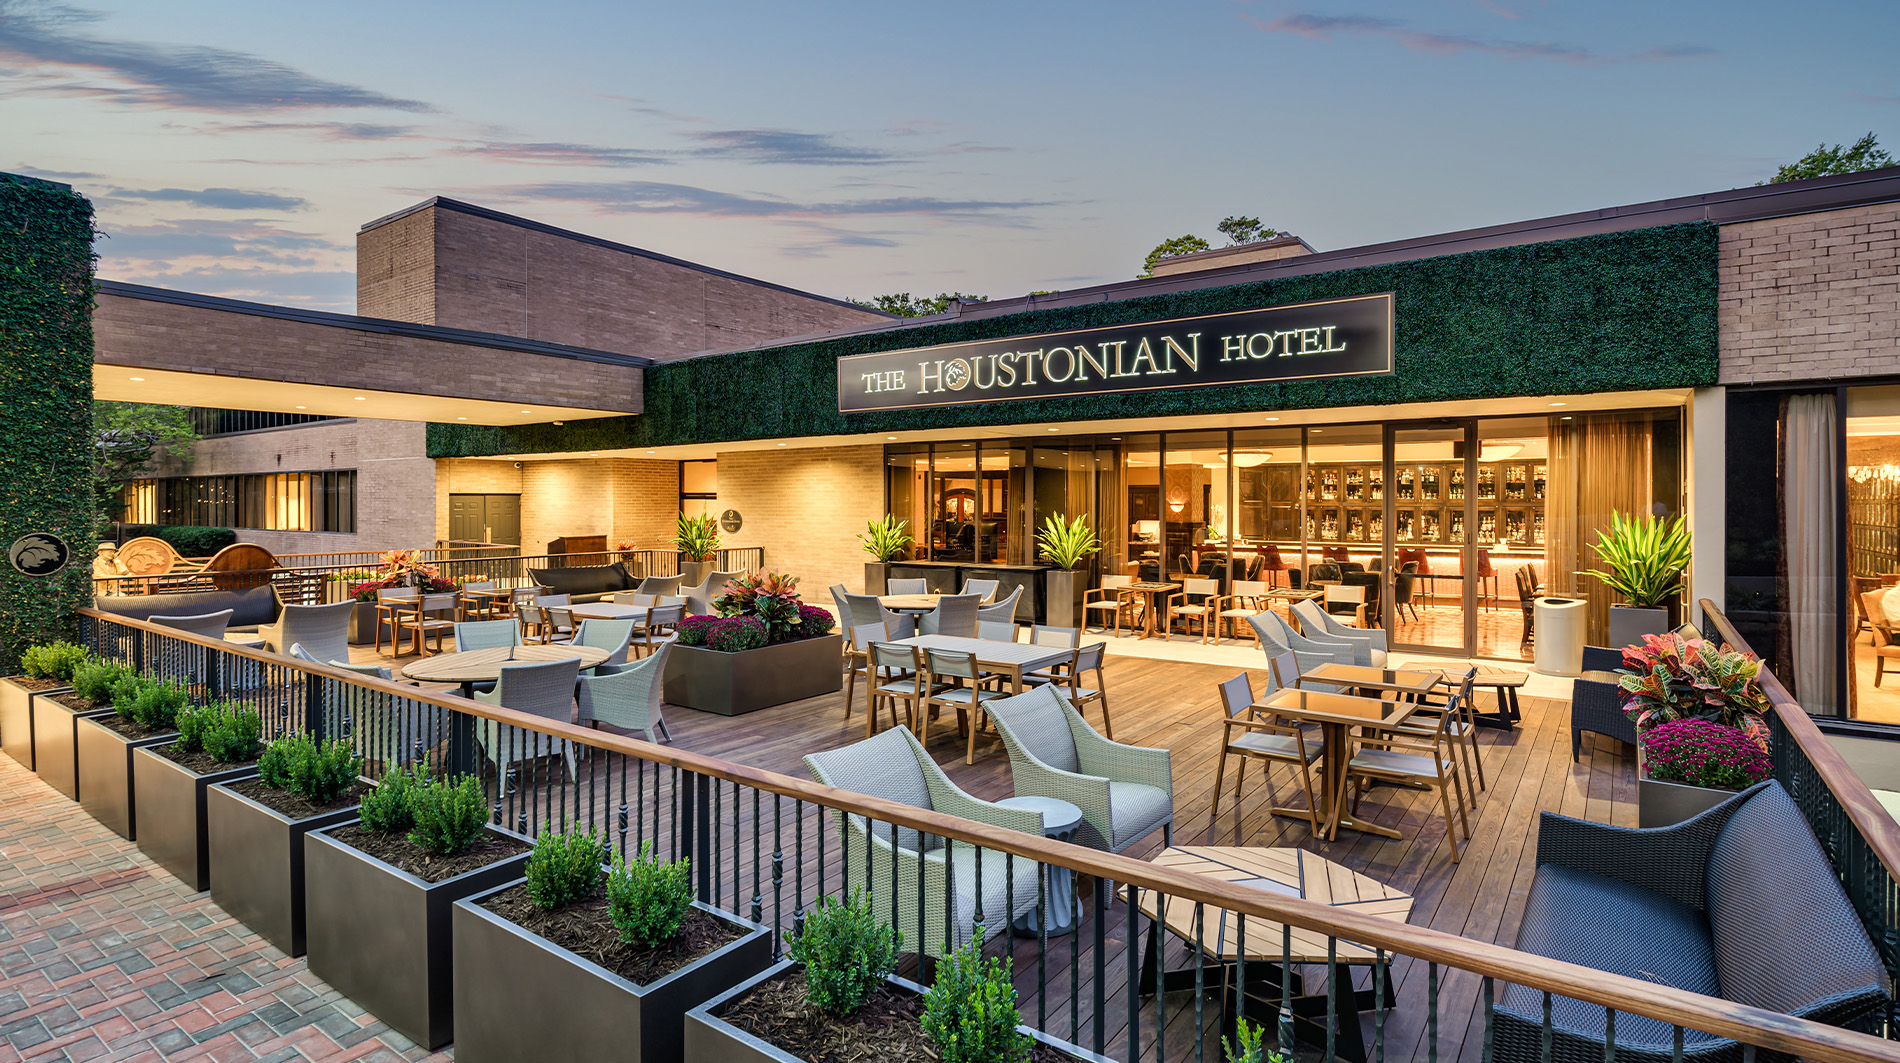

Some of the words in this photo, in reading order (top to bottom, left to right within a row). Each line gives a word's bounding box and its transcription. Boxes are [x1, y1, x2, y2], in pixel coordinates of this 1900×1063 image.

[861, 370, 906, 394] THE
[916, 332, 1201, 395] HOUSTONIAN
[1219, 325, 1346, 362] HOTEL
